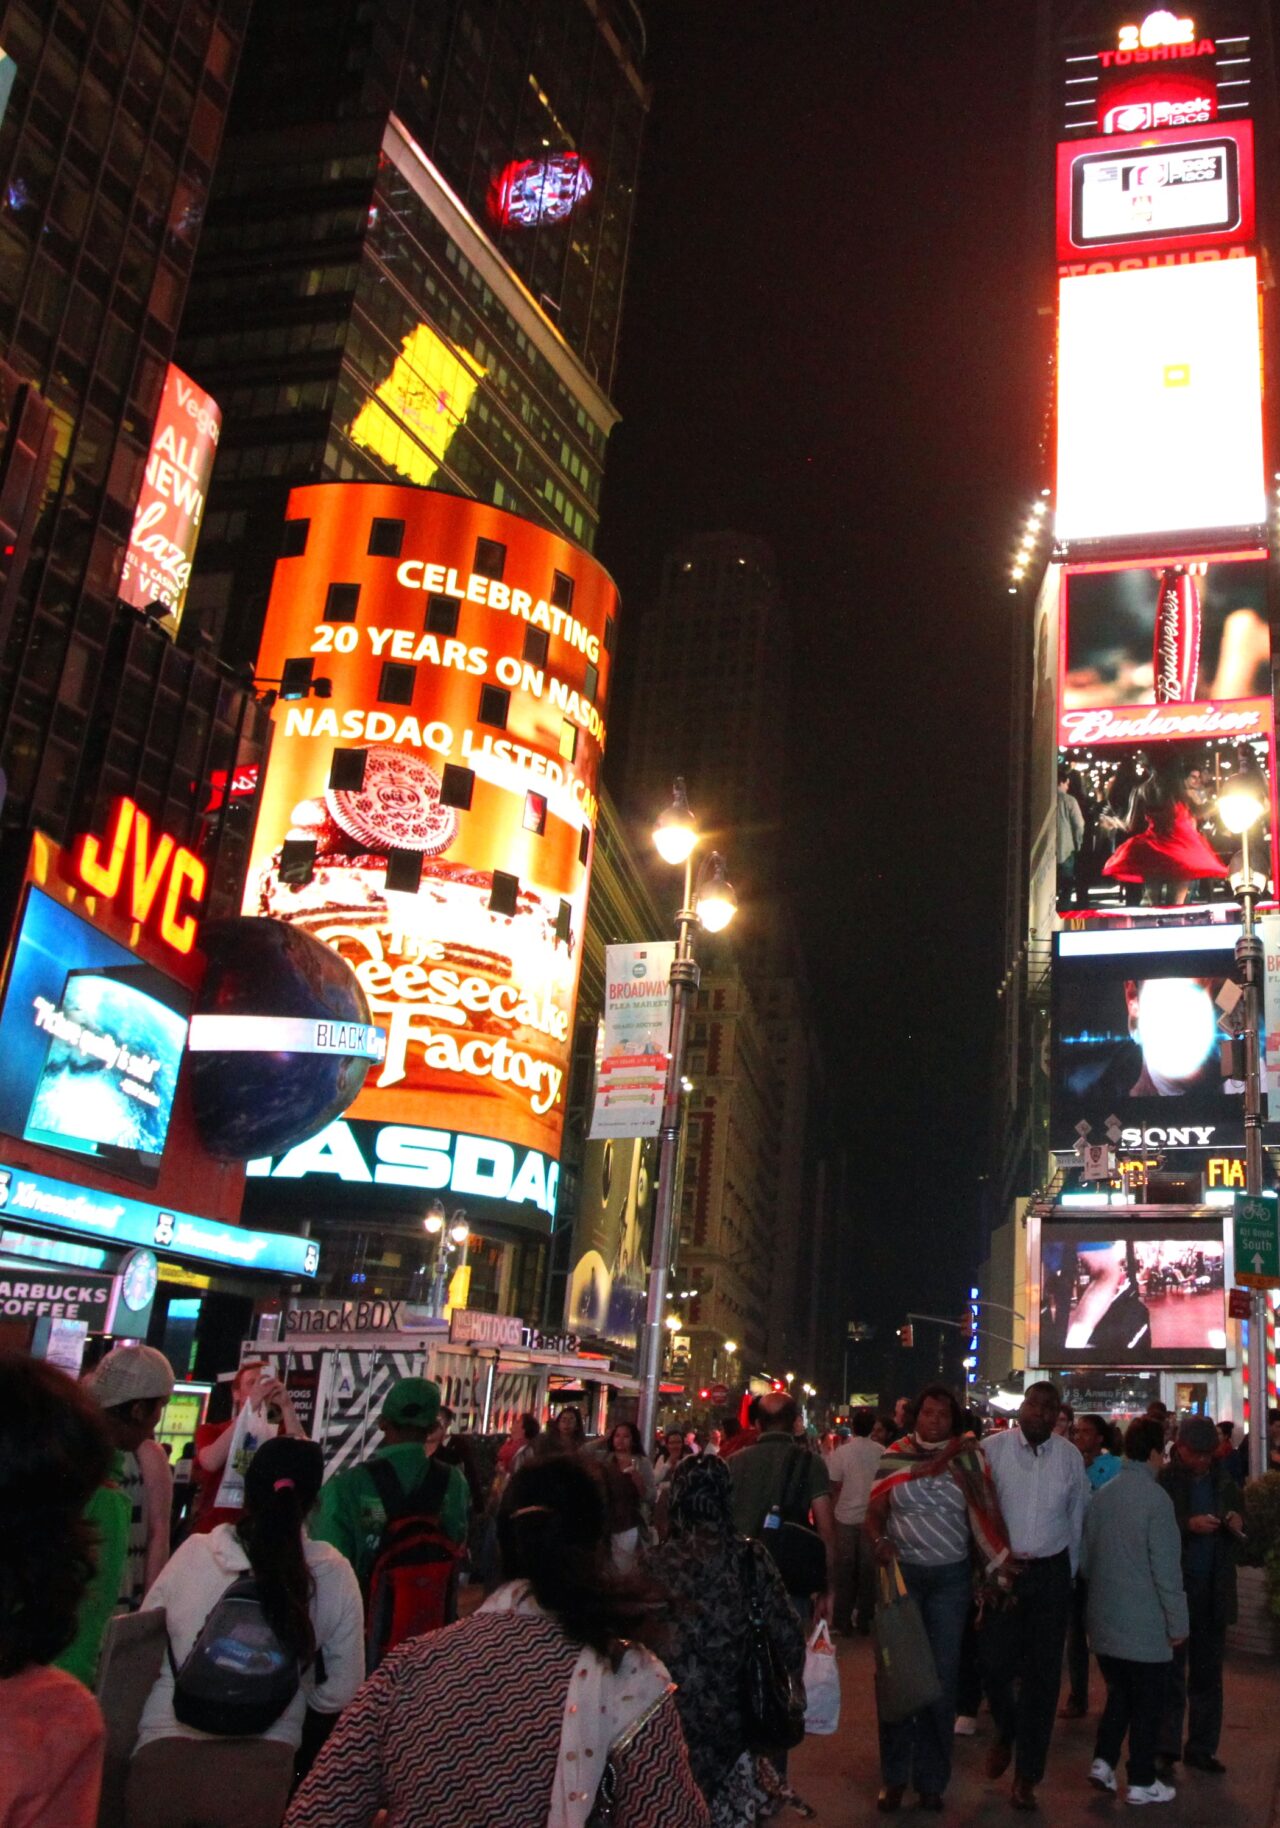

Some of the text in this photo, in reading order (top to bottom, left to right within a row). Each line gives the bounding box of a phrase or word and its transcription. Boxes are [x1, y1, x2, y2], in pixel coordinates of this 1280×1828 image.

[1099, 38, 1216, 68] TOSHIBA
[1153, 98, 1211, 118] Book
[1153, 112, 1210, 128] Place
[175, 378, 219, 446] Vega
[155, 425, 199, 482] ALL
[131, 502, 192, 588] laza
[396, 560, 600, 664] CELEBRATING
[1157, 588, 1182, 703] Budweiser
[310, 624, 359, 654] 20
[366, 626, 489, 676] YEARS
[495, 656, 545, 698] ON
[1061, 708, 1260, 743] Budweiser
[284, 708, 454, 756] NASDAQ
[461, 729, 563, 787] LISTED
[79, 797, 207, 955] JVC
[313, 925, 569, 1043] eesecake
[609, 980, 670, 1000] BROADWAY
[609, 1000, 669, 1010] FLEA MARKET
[316, 1024, 366, 1050] BLACK
[1121, 1126, 1216, 1147] SONY
[245, 1118, 560, 1216] ASDA
[1208, 1158, 1249, 1188] FIA
[1242, 1239, 1272, 1252] South
[0, 1281, 108, 1304] ARBUCKS
[0, 1300, 80, 1319] OFFEE
[493, 1316, 521, 1345] DOGS
[339, 1376, 350, 1393] A
